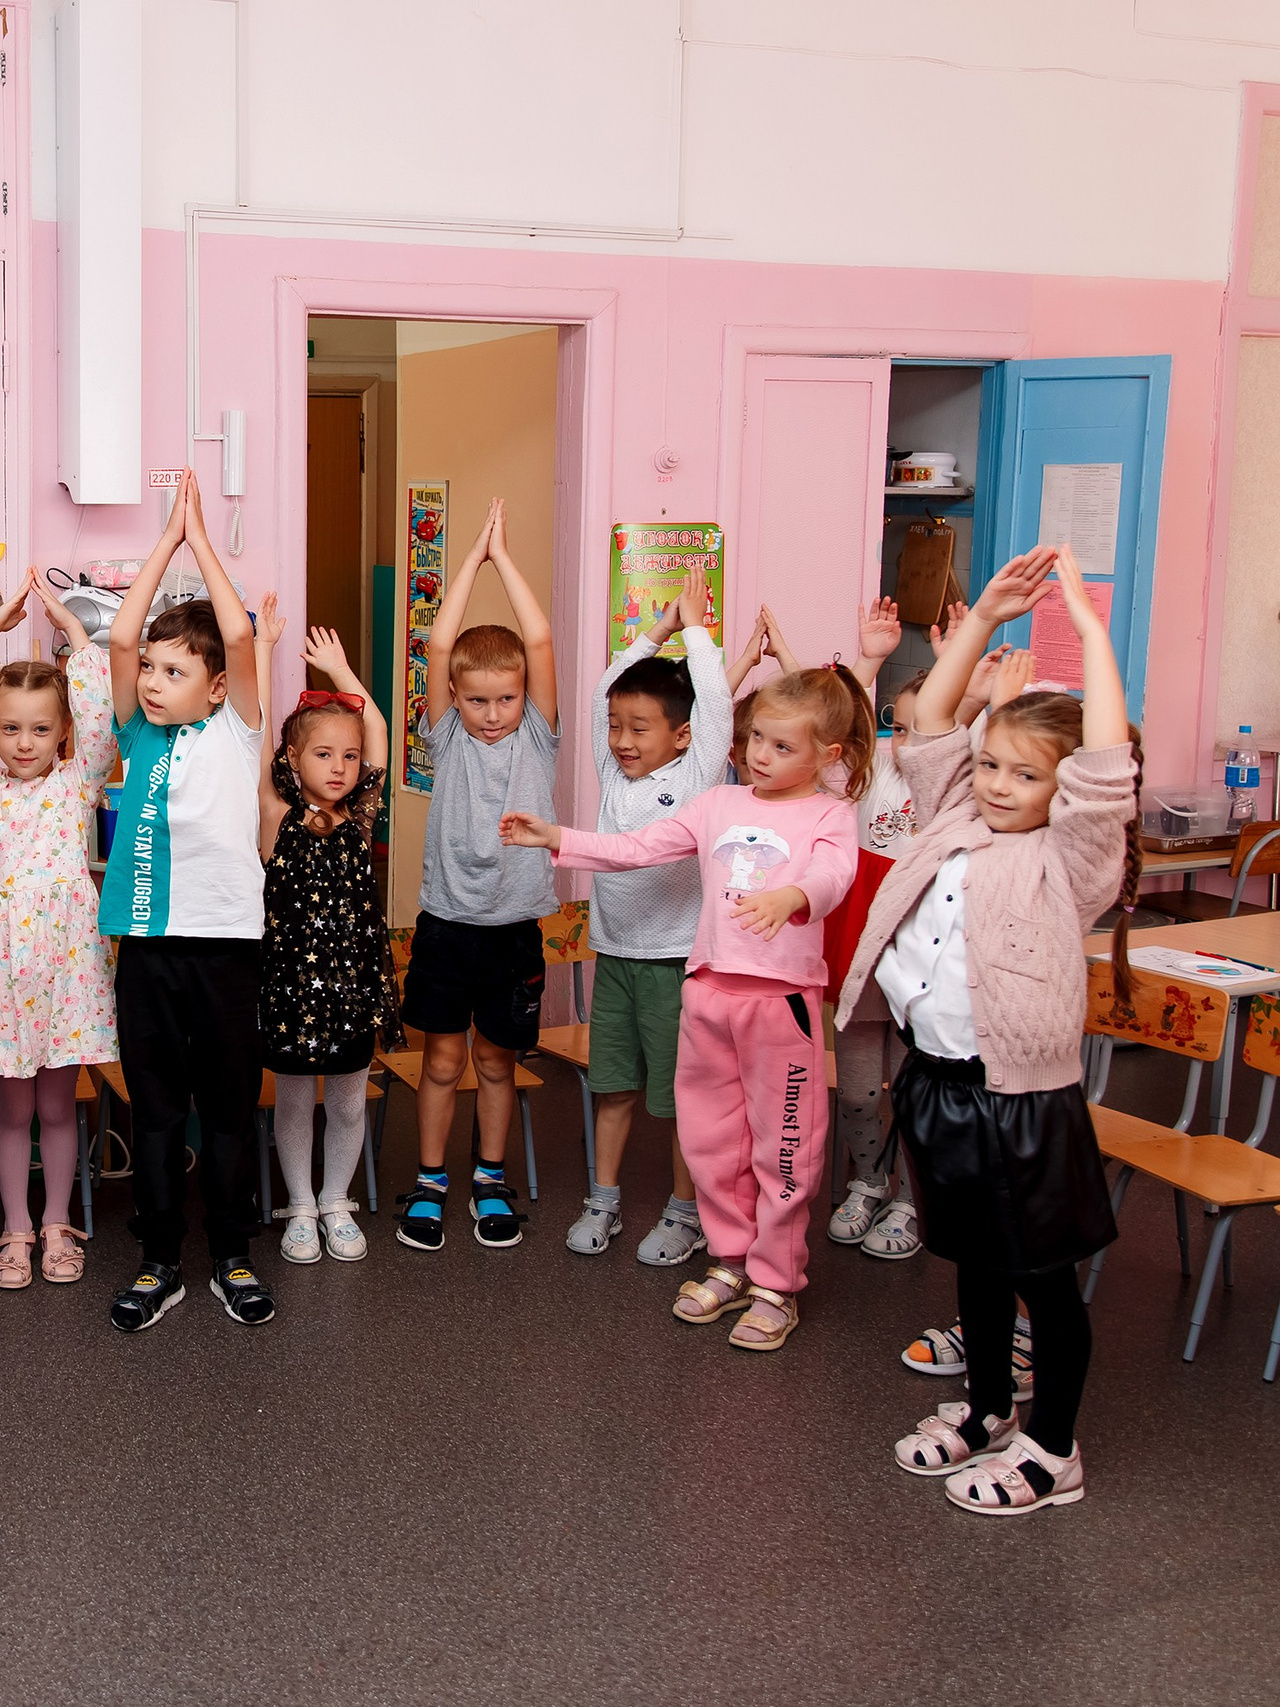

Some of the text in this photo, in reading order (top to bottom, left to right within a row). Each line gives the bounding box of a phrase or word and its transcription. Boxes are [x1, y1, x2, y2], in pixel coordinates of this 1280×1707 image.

[152, 473, 171, 483] 220
[633, 529, 705, 551] УГОЛОК
[140, 803, 158, 821] IN
[133, 824, 154, 861] STAY
[131, 861, 153, 921] PLUGGED
[128, 923, 150, 937] IN
[1230, 1002, 1237, 1015] 2
[782, 1062, 808, 1132] Almost
